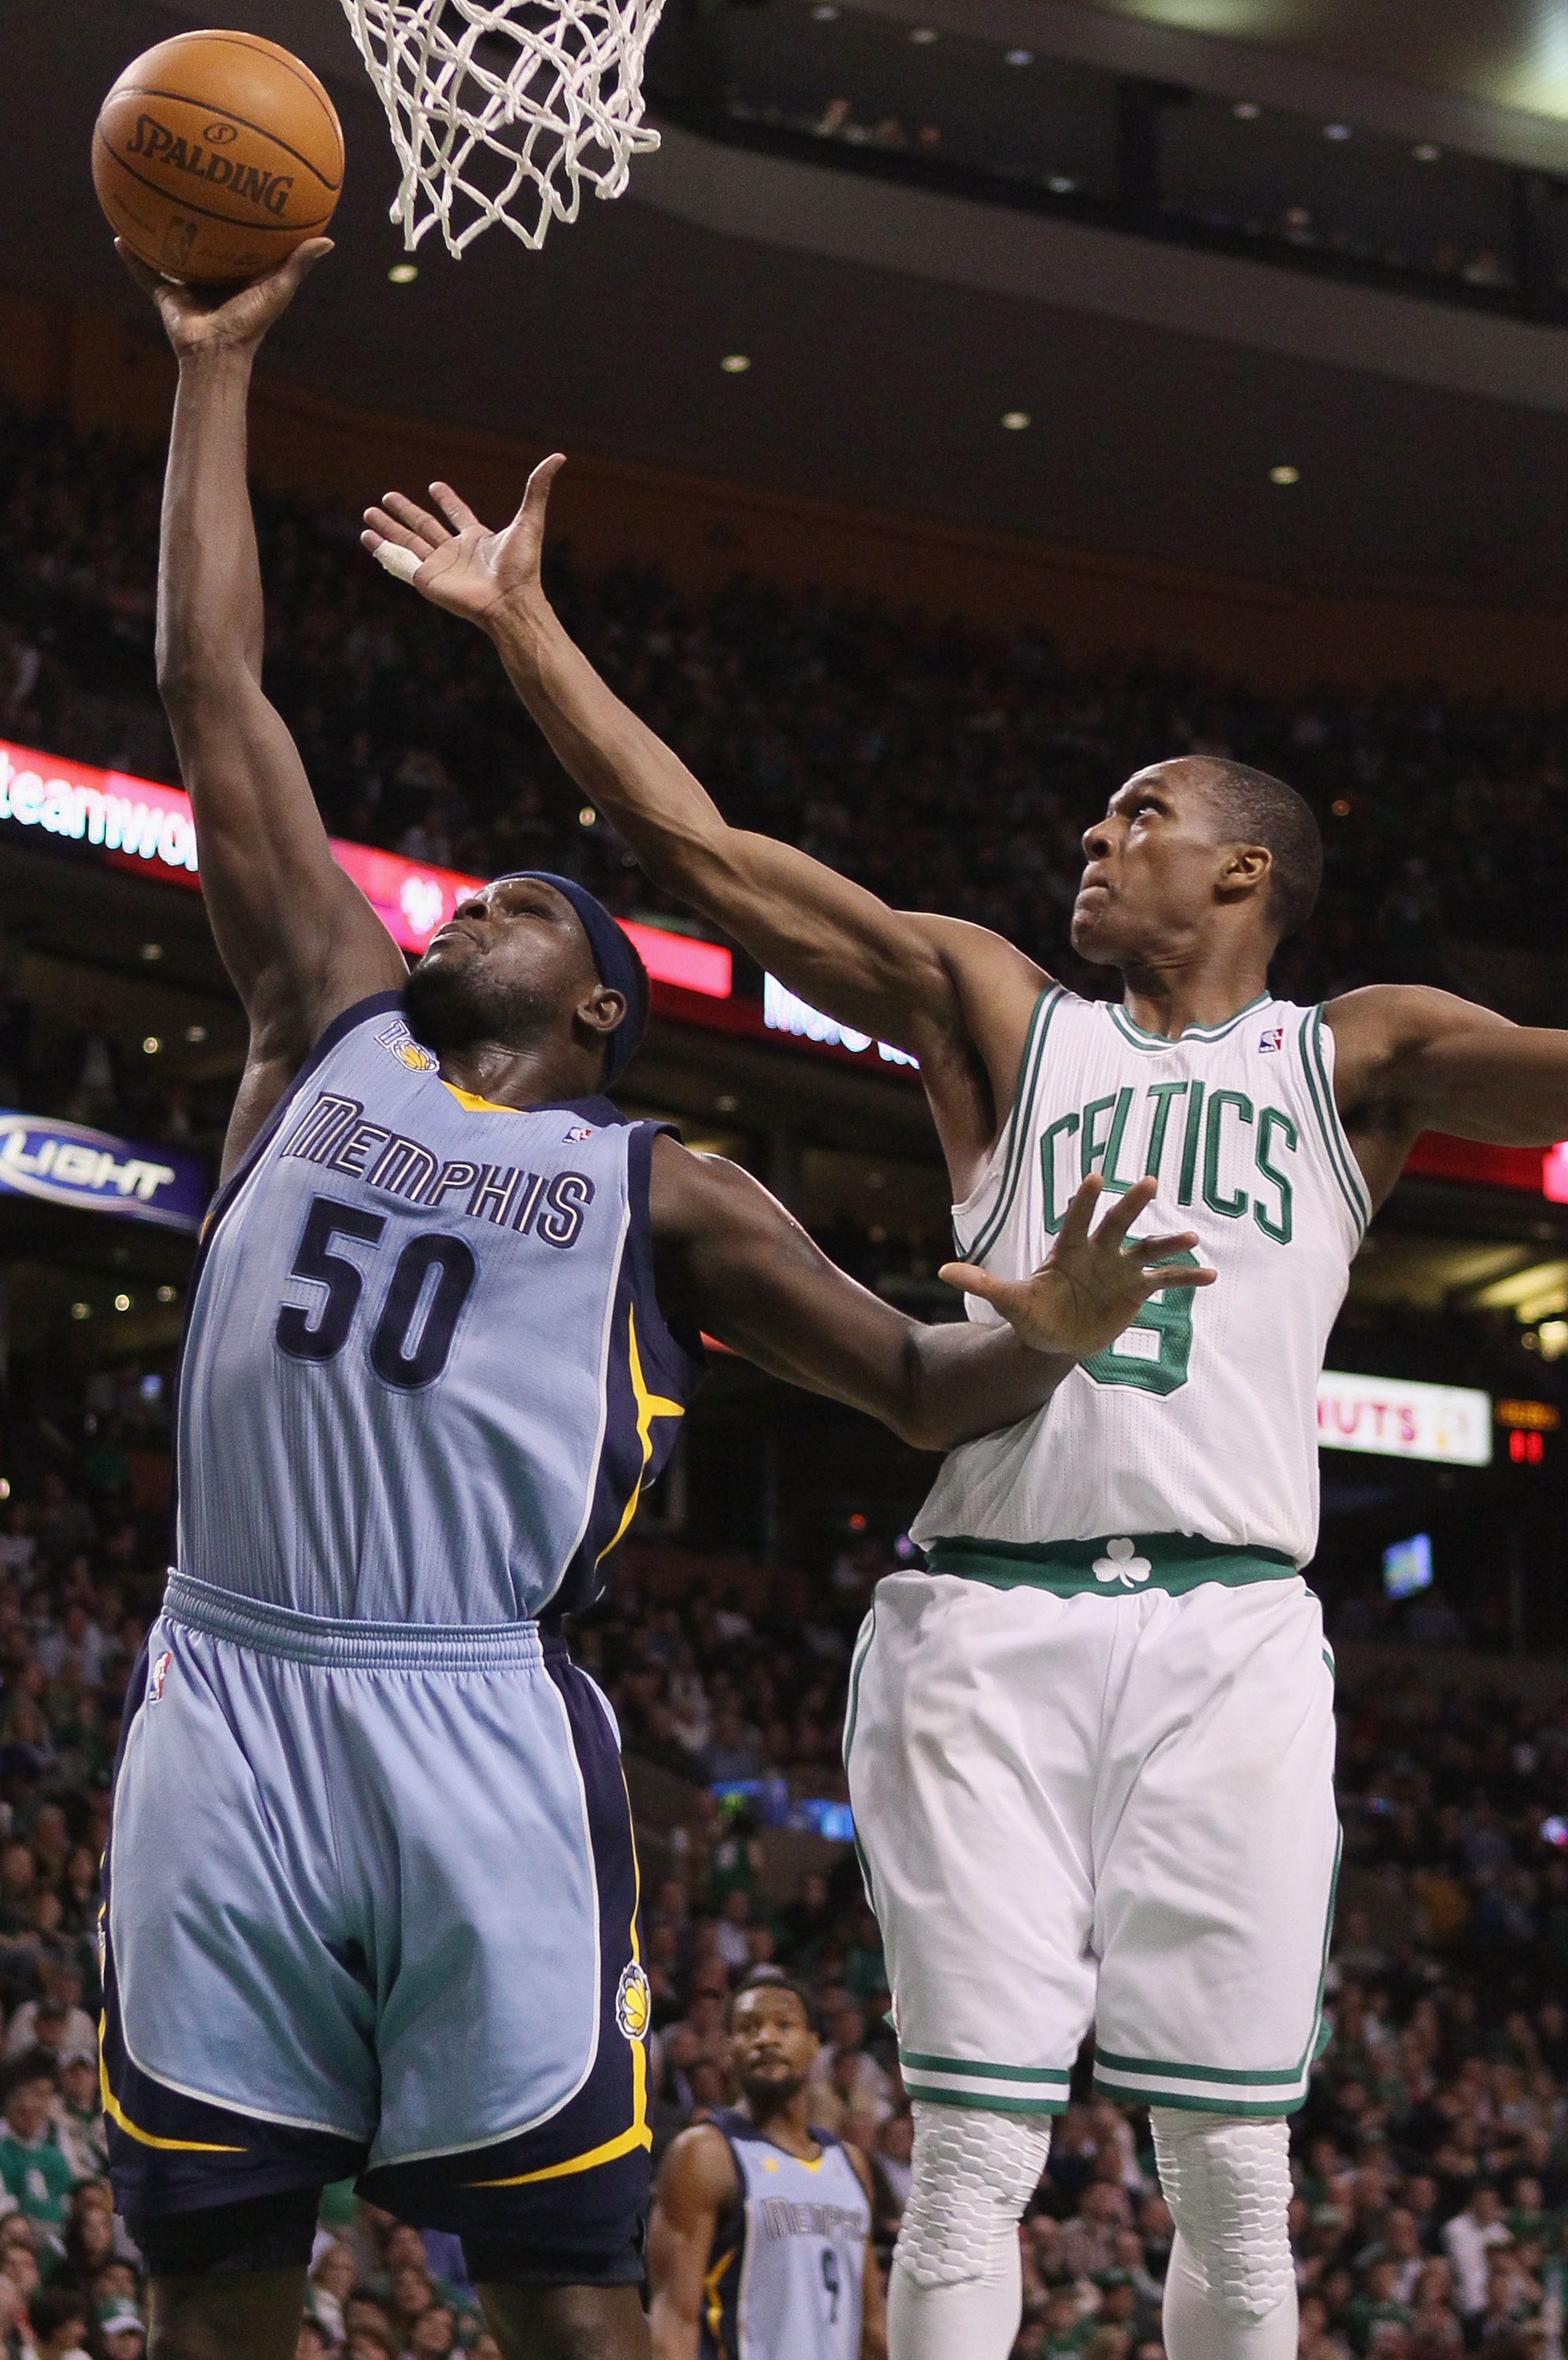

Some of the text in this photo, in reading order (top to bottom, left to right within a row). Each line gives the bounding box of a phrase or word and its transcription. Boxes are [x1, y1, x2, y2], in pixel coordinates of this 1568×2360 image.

[126, 113, 294, 215] SPALDING
[1, 1130, 175, 1200] LIGHT
[281, 1092, 595, 1249] MEMPHIS
[1041, 1080, 1298, 1244] CELTICS
[276, 1195, 477, 1389] 50
